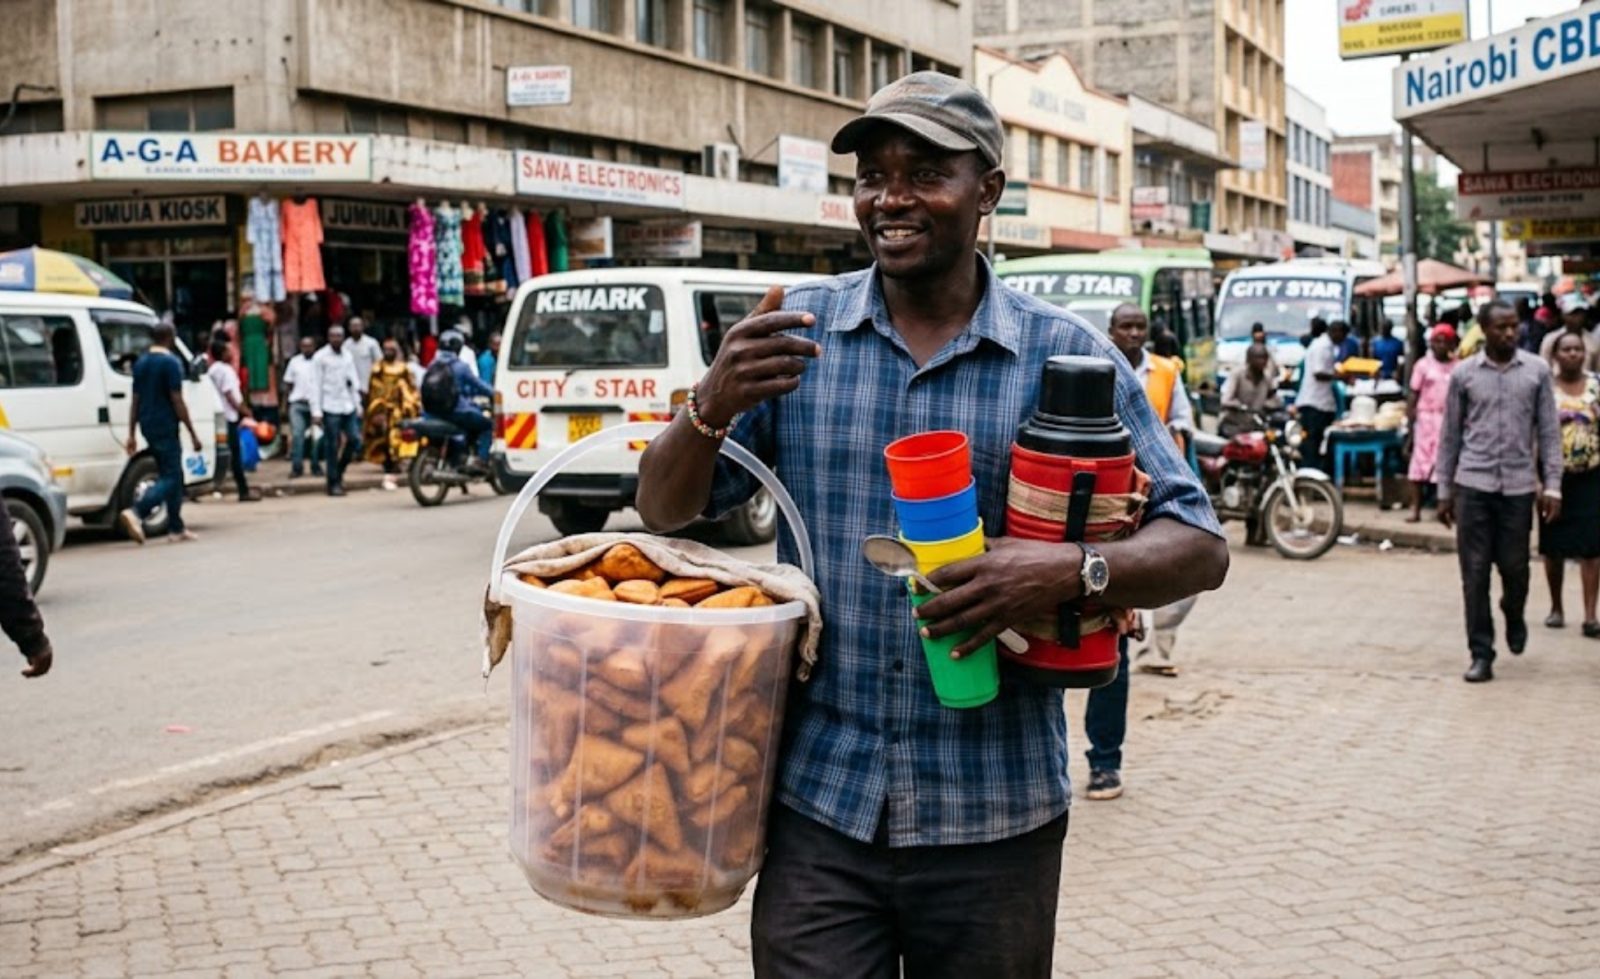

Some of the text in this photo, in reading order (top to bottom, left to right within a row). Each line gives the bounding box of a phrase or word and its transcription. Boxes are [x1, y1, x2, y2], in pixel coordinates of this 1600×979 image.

[1406, 37, 1517, 106] Nairobi
[101, 138, 358, 165] A-G-A BAKERY
[522, 155, 572, 183] SAWA
[577, 163, 681, 196] ELECTRONICS
[1463, 175, 1508, 192] SAWA
[80, 200, 221, 224] JUMUIA KIOSK
[1002, 273, 1134, 296] CITY STAR
[1231, 280, 1344, 299] CITY STAR
[536, 287, 648, 313] KEMARK
[516, 378, 657, 399] CITY STAR
